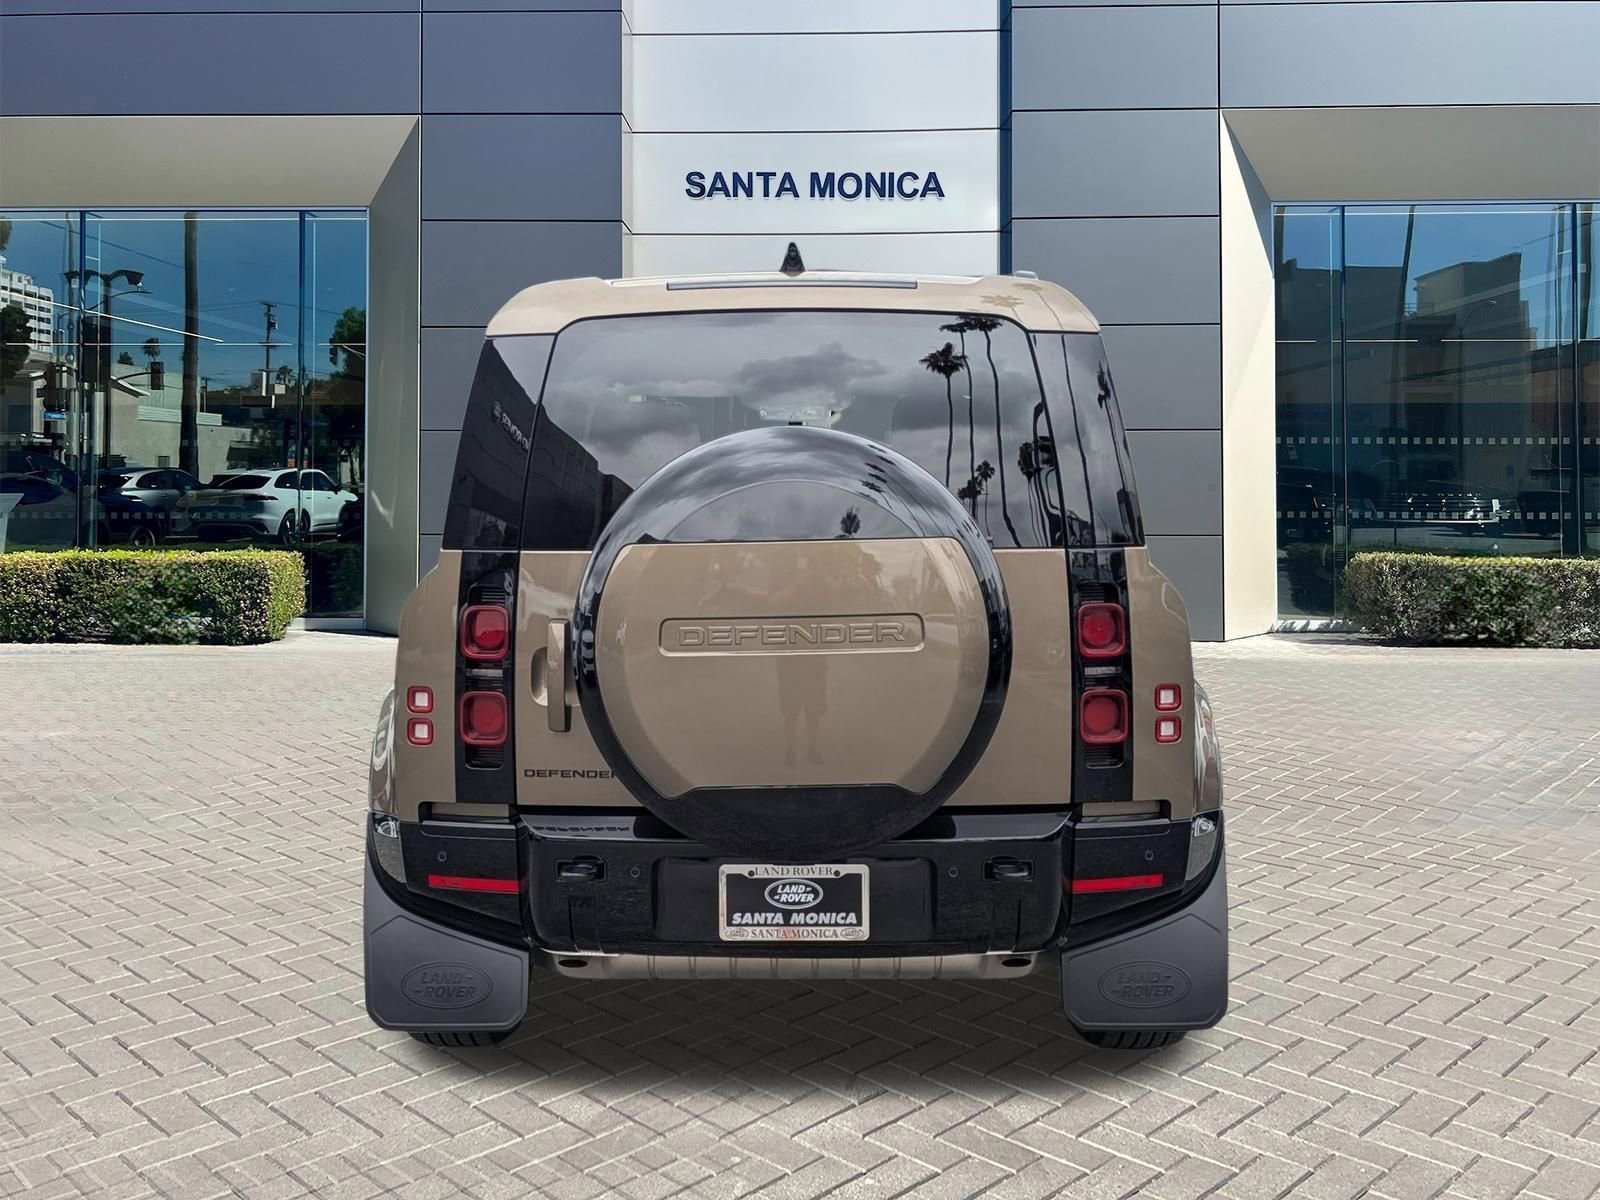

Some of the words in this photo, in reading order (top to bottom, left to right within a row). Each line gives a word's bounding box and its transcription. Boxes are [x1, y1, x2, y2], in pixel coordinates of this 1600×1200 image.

[685, 171, 800, 199] SANTA
[809, 171, 945, 199] MONICA
[679, 622, 905, 646] DEFENDER
[755, 867, 790, 876] LAND
[793, 866, 833, 876] ROVER
[732, 912, 785, 925] SANTA
[789, 912, 857, 925] MONICA
[751, 928, 789, 938] SANTA
[790, 928, 839, 938] MONICA
